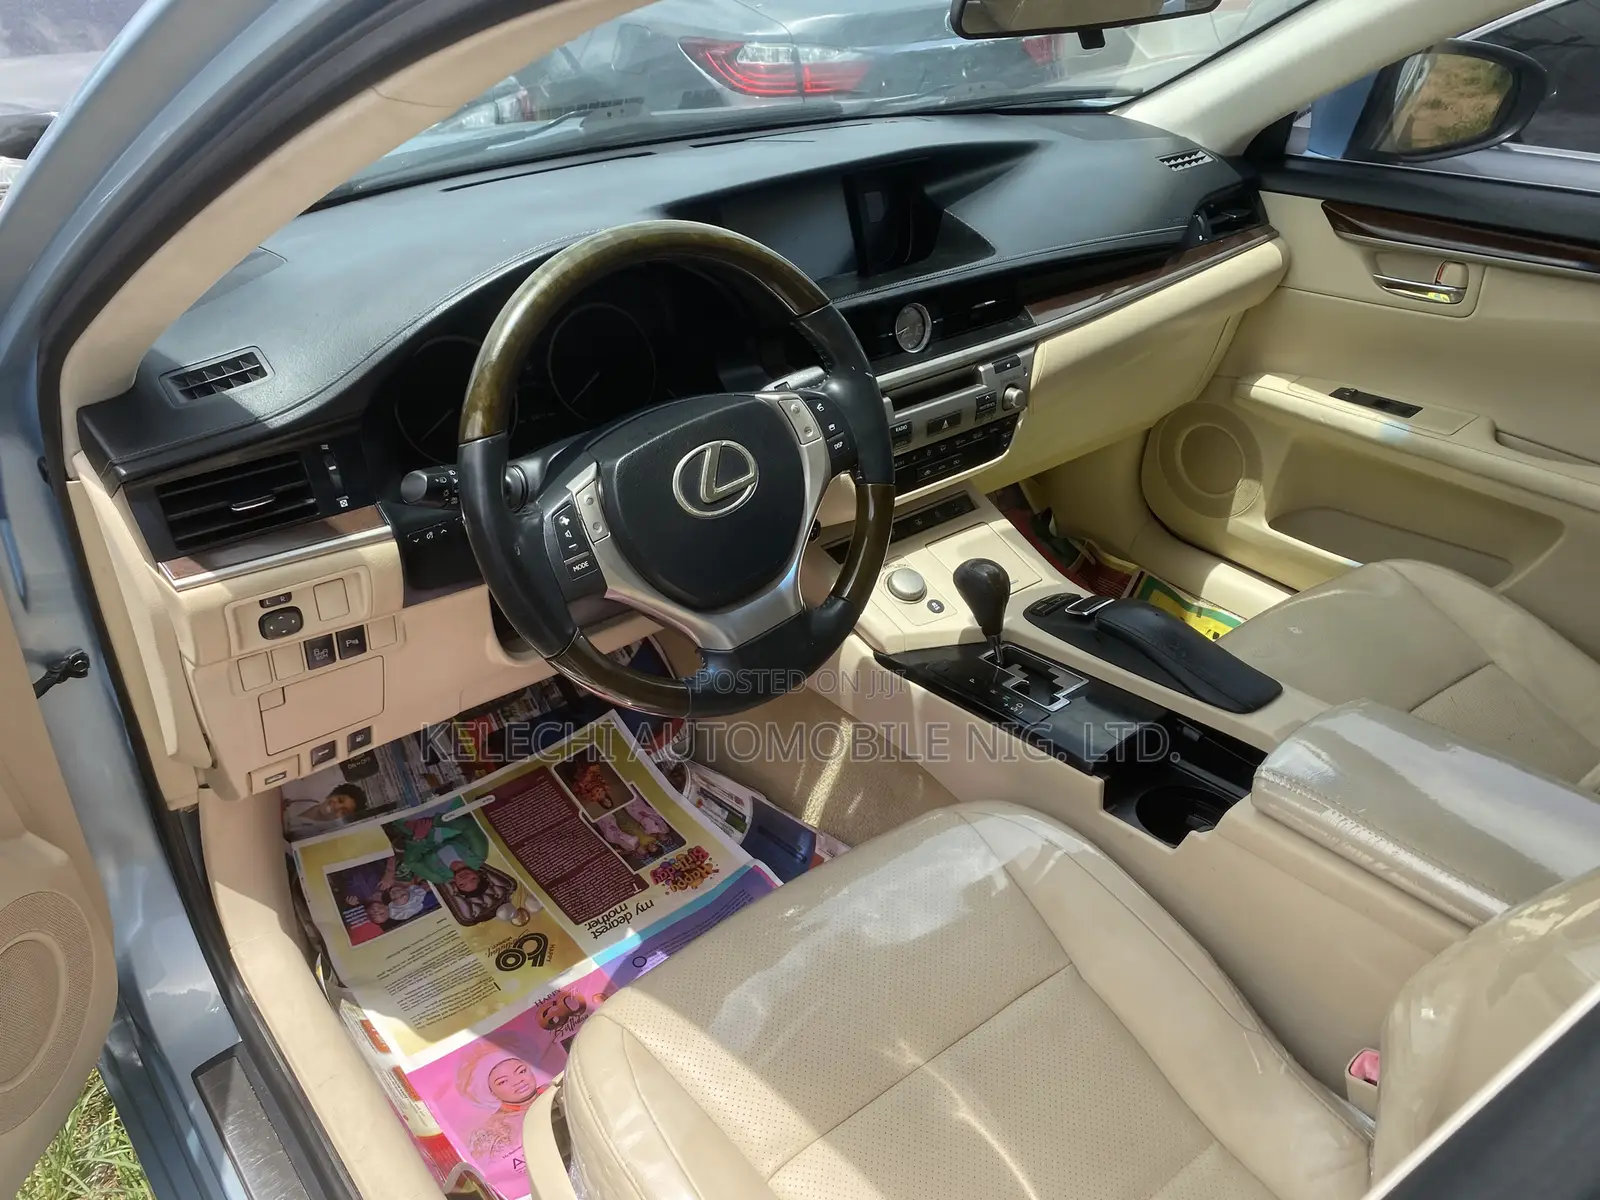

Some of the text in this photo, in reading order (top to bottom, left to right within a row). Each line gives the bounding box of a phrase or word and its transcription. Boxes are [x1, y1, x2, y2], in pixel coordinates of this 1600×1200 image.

[895, 424, 908, 433] RADIO
[572, 560, 590, 573] MODE
[584, 903, 629, 931] mother.
[591, 899, 655, 940] my dearest
[495, 932, 549, 972] 60
[534, 987, 562, 1008] HAPPY
[535, 991, 588, 1031] 60
